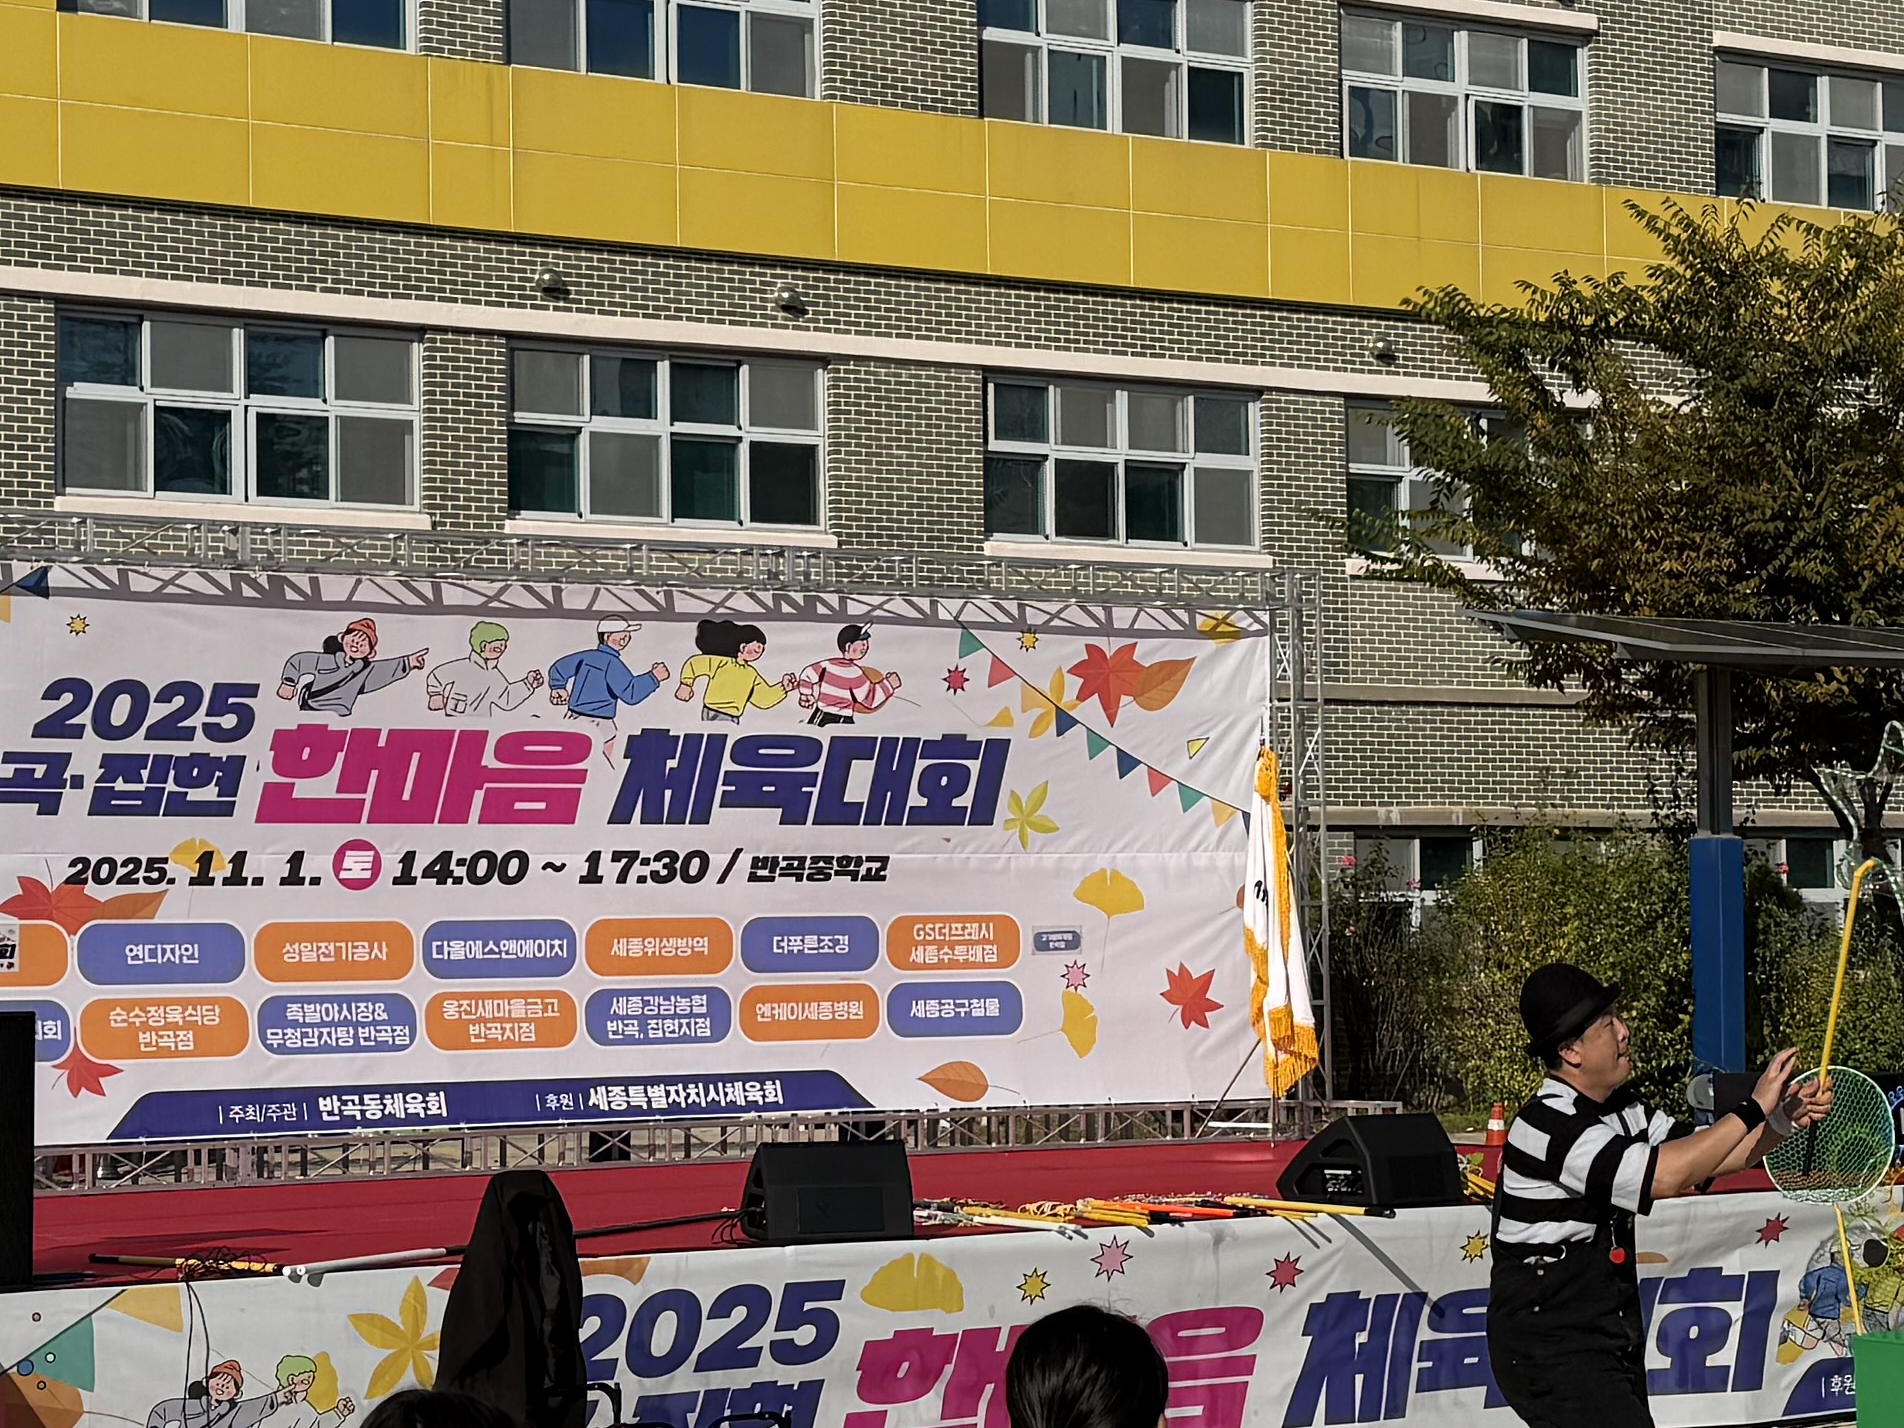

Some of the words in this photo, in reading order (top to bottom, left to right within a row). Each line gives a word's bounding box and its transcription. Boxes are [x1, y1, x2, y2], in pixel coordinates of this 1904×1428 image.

[30, 677, 261, 743] 2025
[254, 723, 593, 825] 한마음
[607, 727, 1012, 827] 체육대회
[64, 856, 177, 887] 2025.
[189, 850, 265, 888] 11.
[278, 850, 322, 887] 1.
[340, 849, 377, 882] 토
[392, 848, 527, 887] 14:00
[579, 848, 711, 885] 17:30
[747, 854, 891, 884] 반곡중학교
[913, 922, 995, 941] GS더프레시
[125, 942, 200, 966] 연디자인
[282, 941, 389, 963] 성일전기공사
[610, 936, 710, 957] 세종위생방역
[772, 934, 850, 955] 더푸른조경
[108, 1002, 222, 1028] 순수정육식당
[286, 1002, 388, 1023] 족발야시장&
[610, 994, 708, 1016] 세종강남농협
[755, 1001, 864, 1022] 엔케이세종병원
[138, 1029, 195, 1052] 반곡점
[266, 1027, 354, 1048] 무청감자탕
[358, 1025, 410, 1046] 반곡점
[469, 1022, 536, 1043] 반곡지점
[318, 1090, 448, 1122] 반곡동체육회
[545, 1090, 574, 1111] 후원
[587, 1079, 785, 1110] 세종특별자치시체육회
[580, 1279, 846, 1381] 2025
